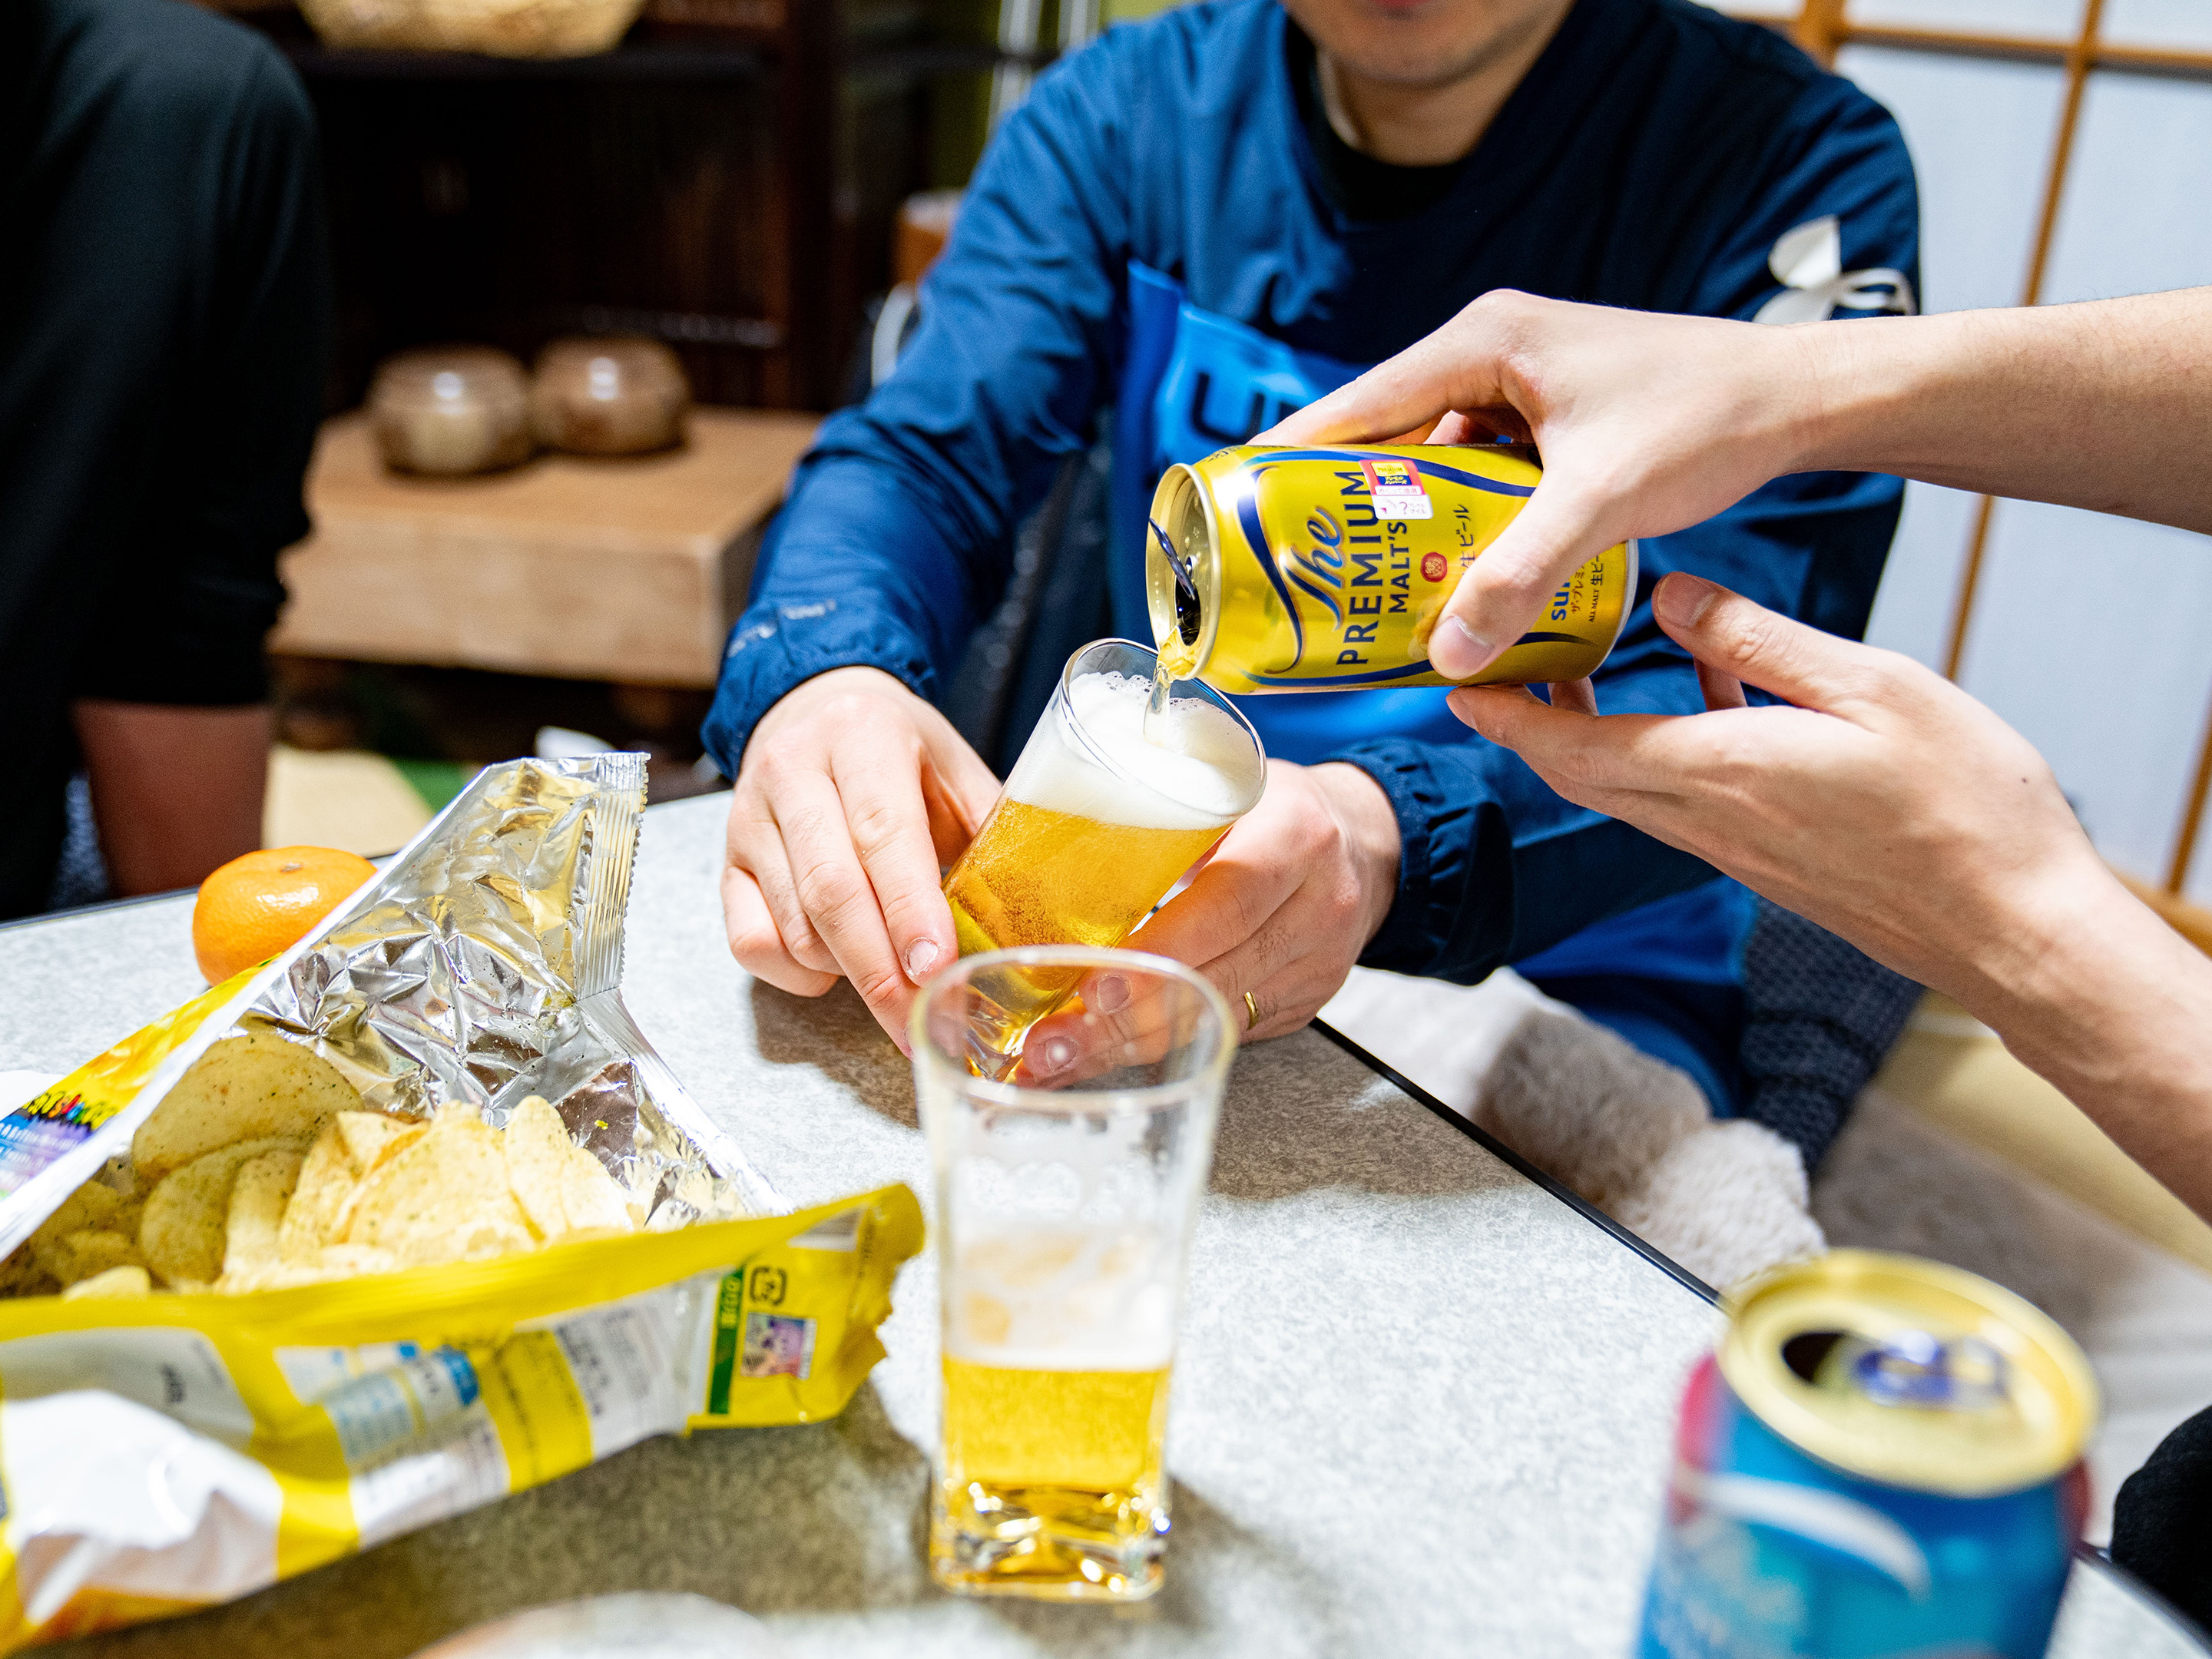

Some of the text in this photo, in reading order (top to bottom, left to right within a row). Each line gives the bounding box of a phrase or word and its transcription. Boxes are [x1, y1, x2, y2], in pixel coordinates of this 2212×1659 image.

[1334, 470, 1383, 666] PREMIUM
[1387, 521, 1411, 614] MALT'S
[1452, 504, 1475, 575] 生ビール
[1571, 565, 1585, 614] ザ・プレミ
